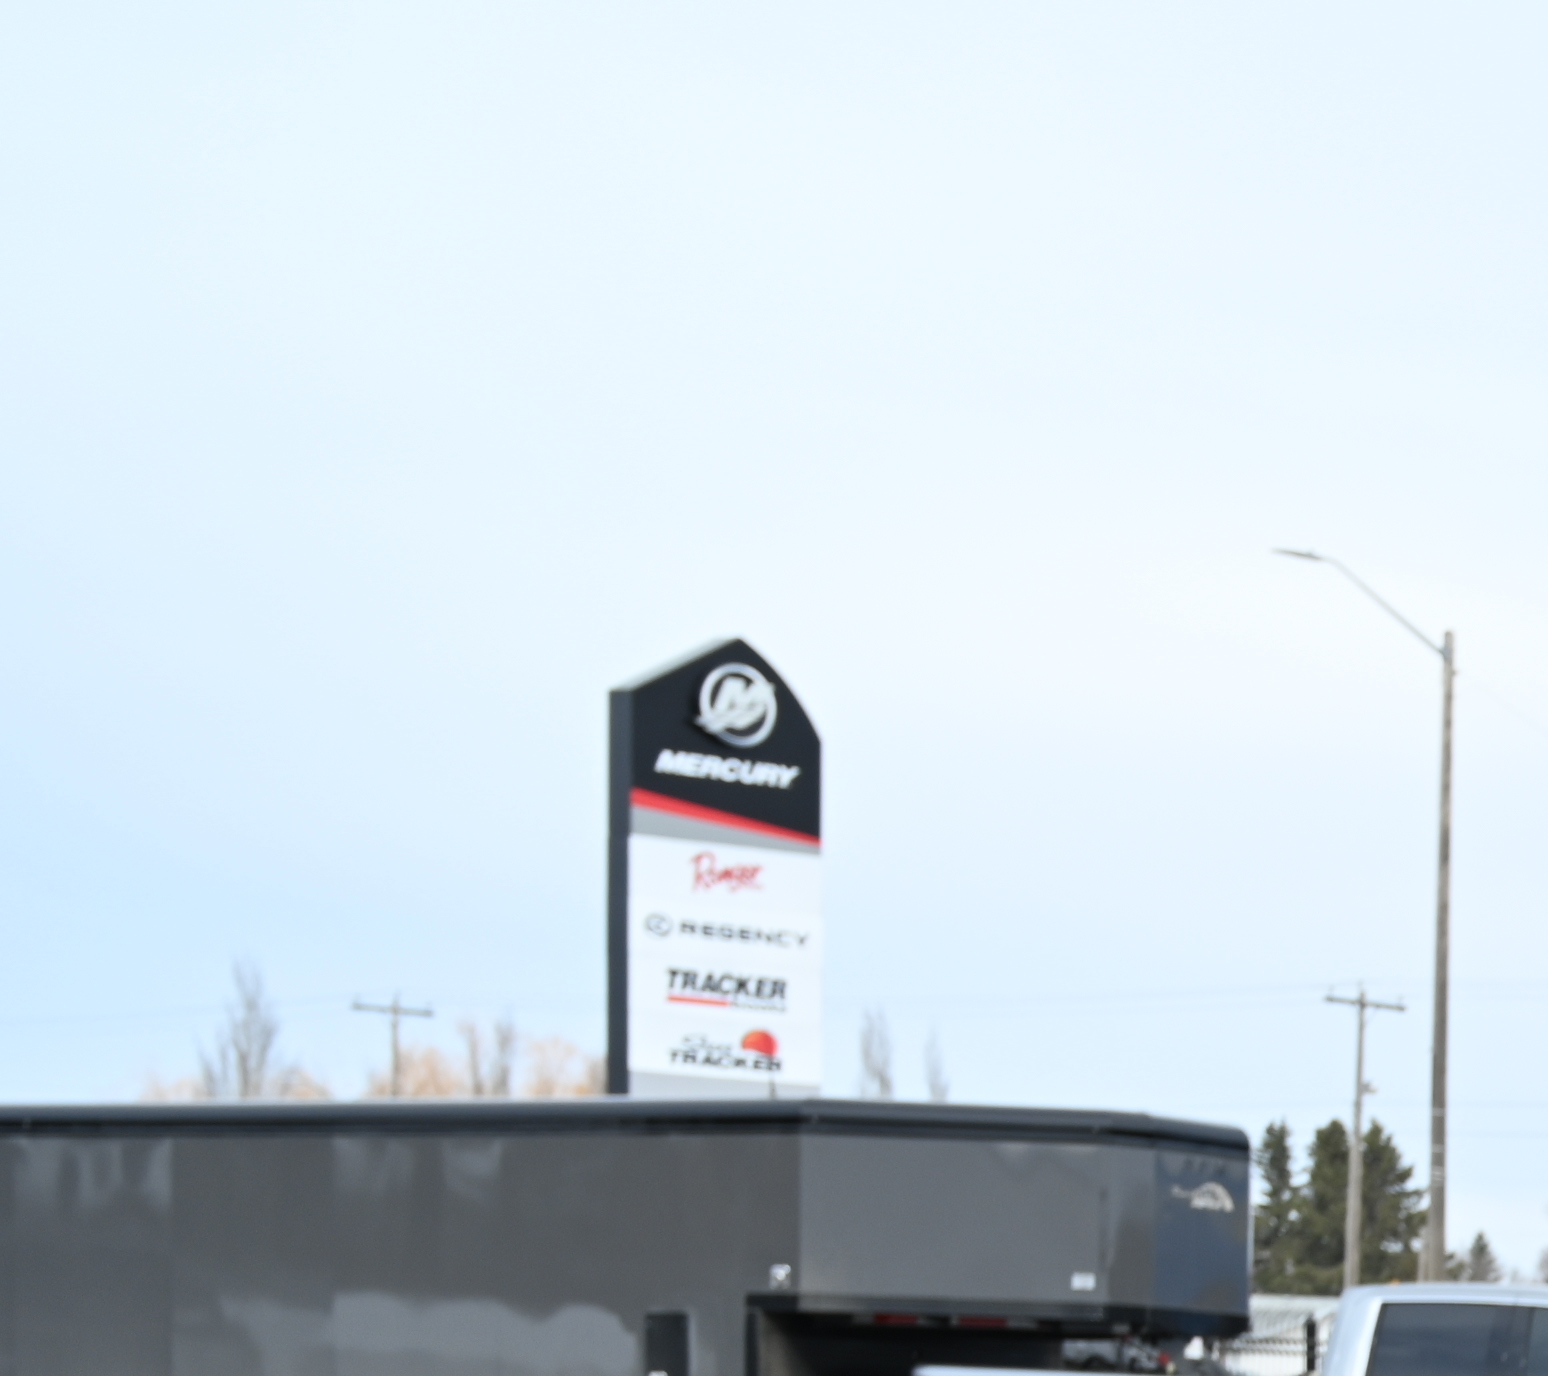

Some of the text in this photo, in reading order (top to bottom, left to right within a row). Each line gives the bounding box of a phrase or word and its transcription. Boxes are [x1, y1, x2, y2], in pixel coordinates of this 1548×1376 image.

[655, 748, 802, 790] MERCURY
[678, 918, 811, 950] REGENCY
[667, 968, 787, 1000] TRACKER
[669, 1050, 783, 1073] TRACKER
